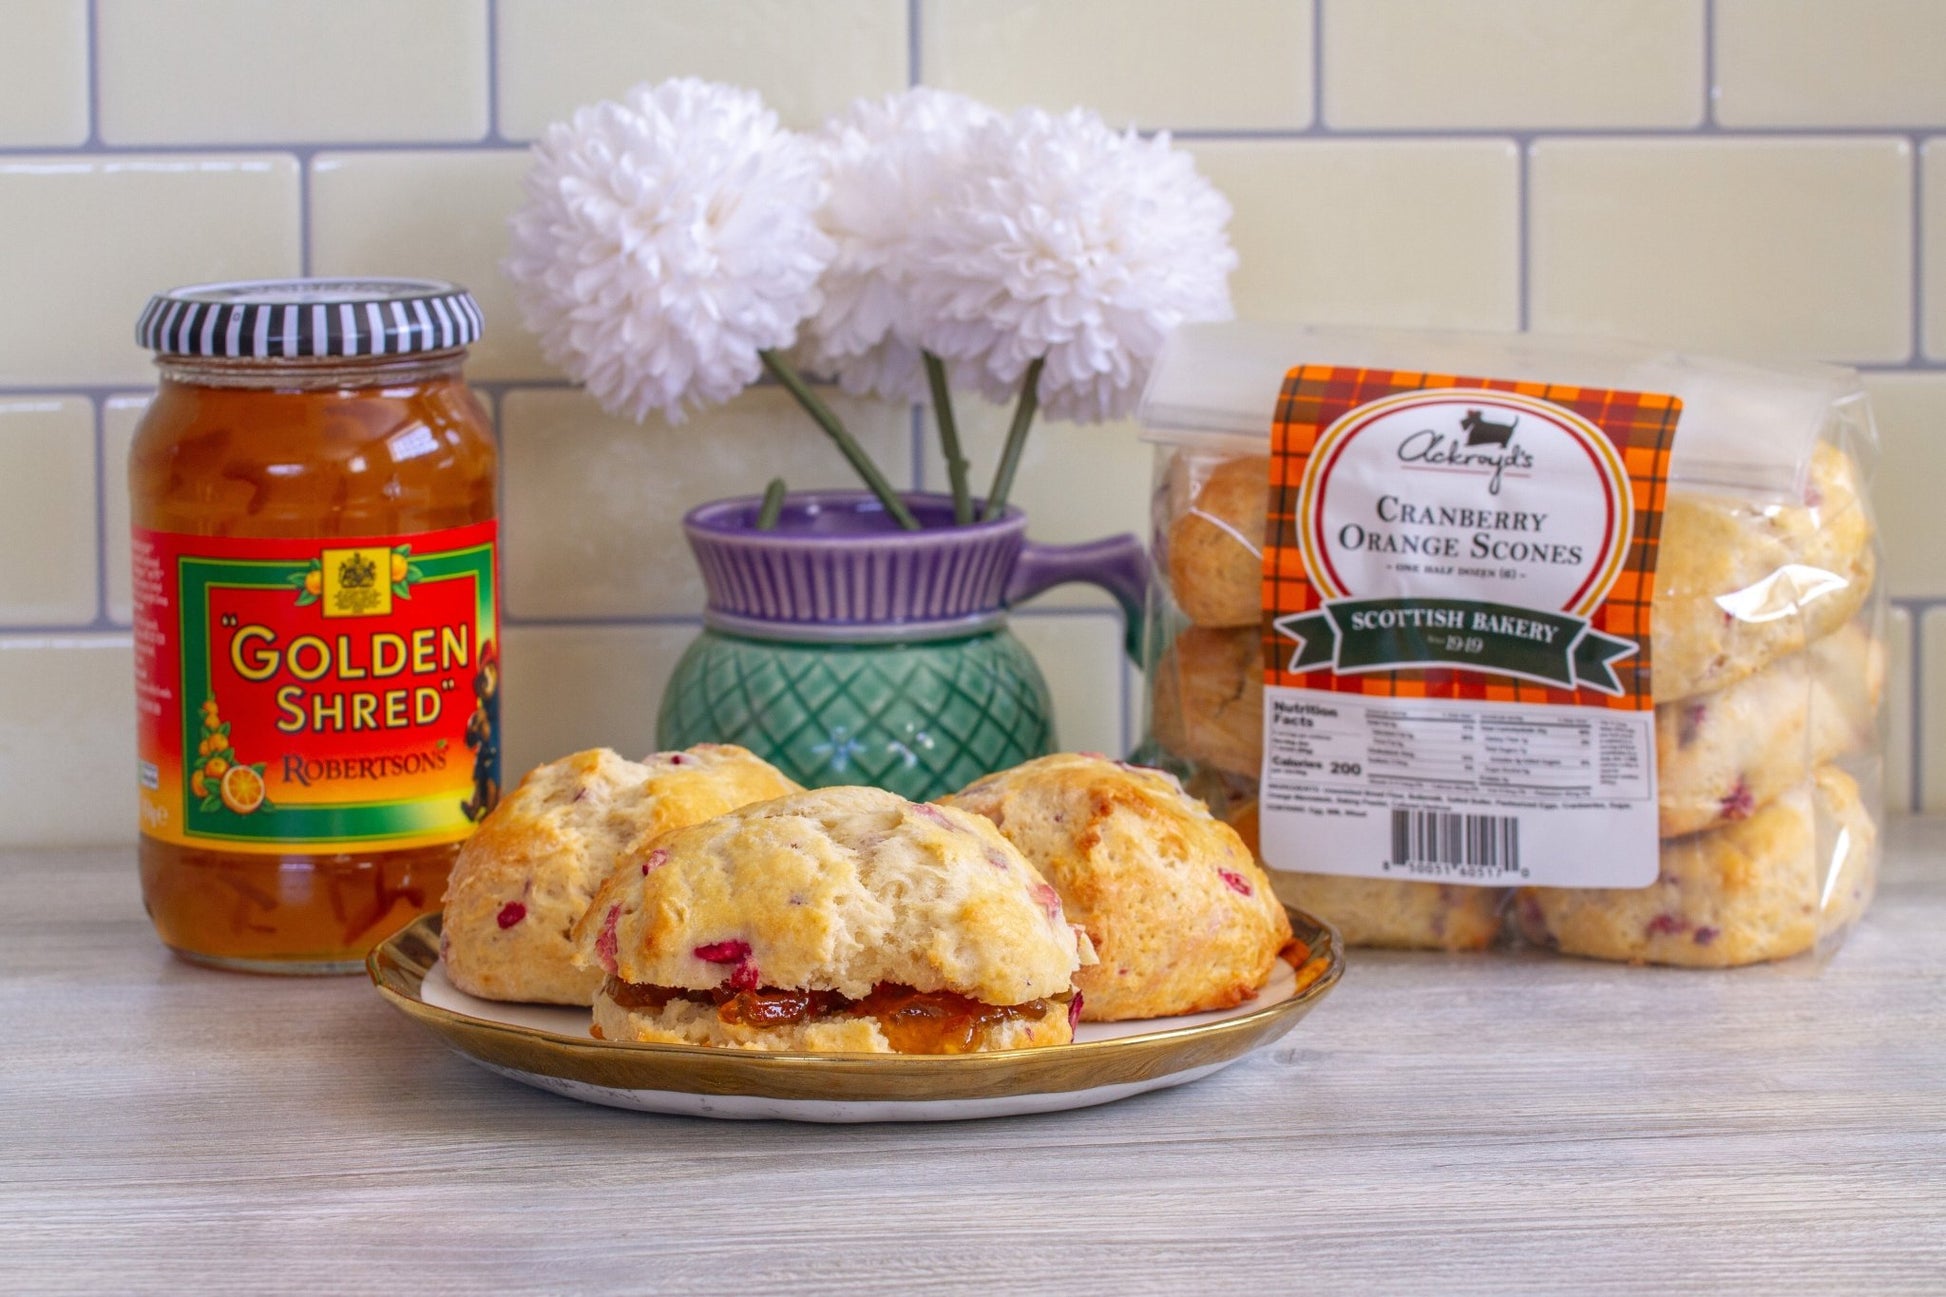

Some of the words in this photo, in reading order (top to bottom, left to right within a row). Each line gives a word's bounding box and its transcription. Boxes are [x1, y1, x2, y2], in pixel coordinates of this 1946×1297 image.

[1398, 430, 1534, 495] Ackroyd's
[1376, 495, 1548, 532] CRANBERRY
[1338, 523, 1460, 558] ORANGE
[1470, 532, 1583, 566] SCONES
[1424, 565, 1454, 575] HALF
[1351, 609, 1465, 631] SCOTTISH
[1470, 611, 1560, 644] BAKERY
[1274, 701, 1338, 718] Nutrition
[1274, 713, 1314, 727] Facts
[1272, 756, 1323, 769] Calories
[1330, 761, 1362, 776] 200
